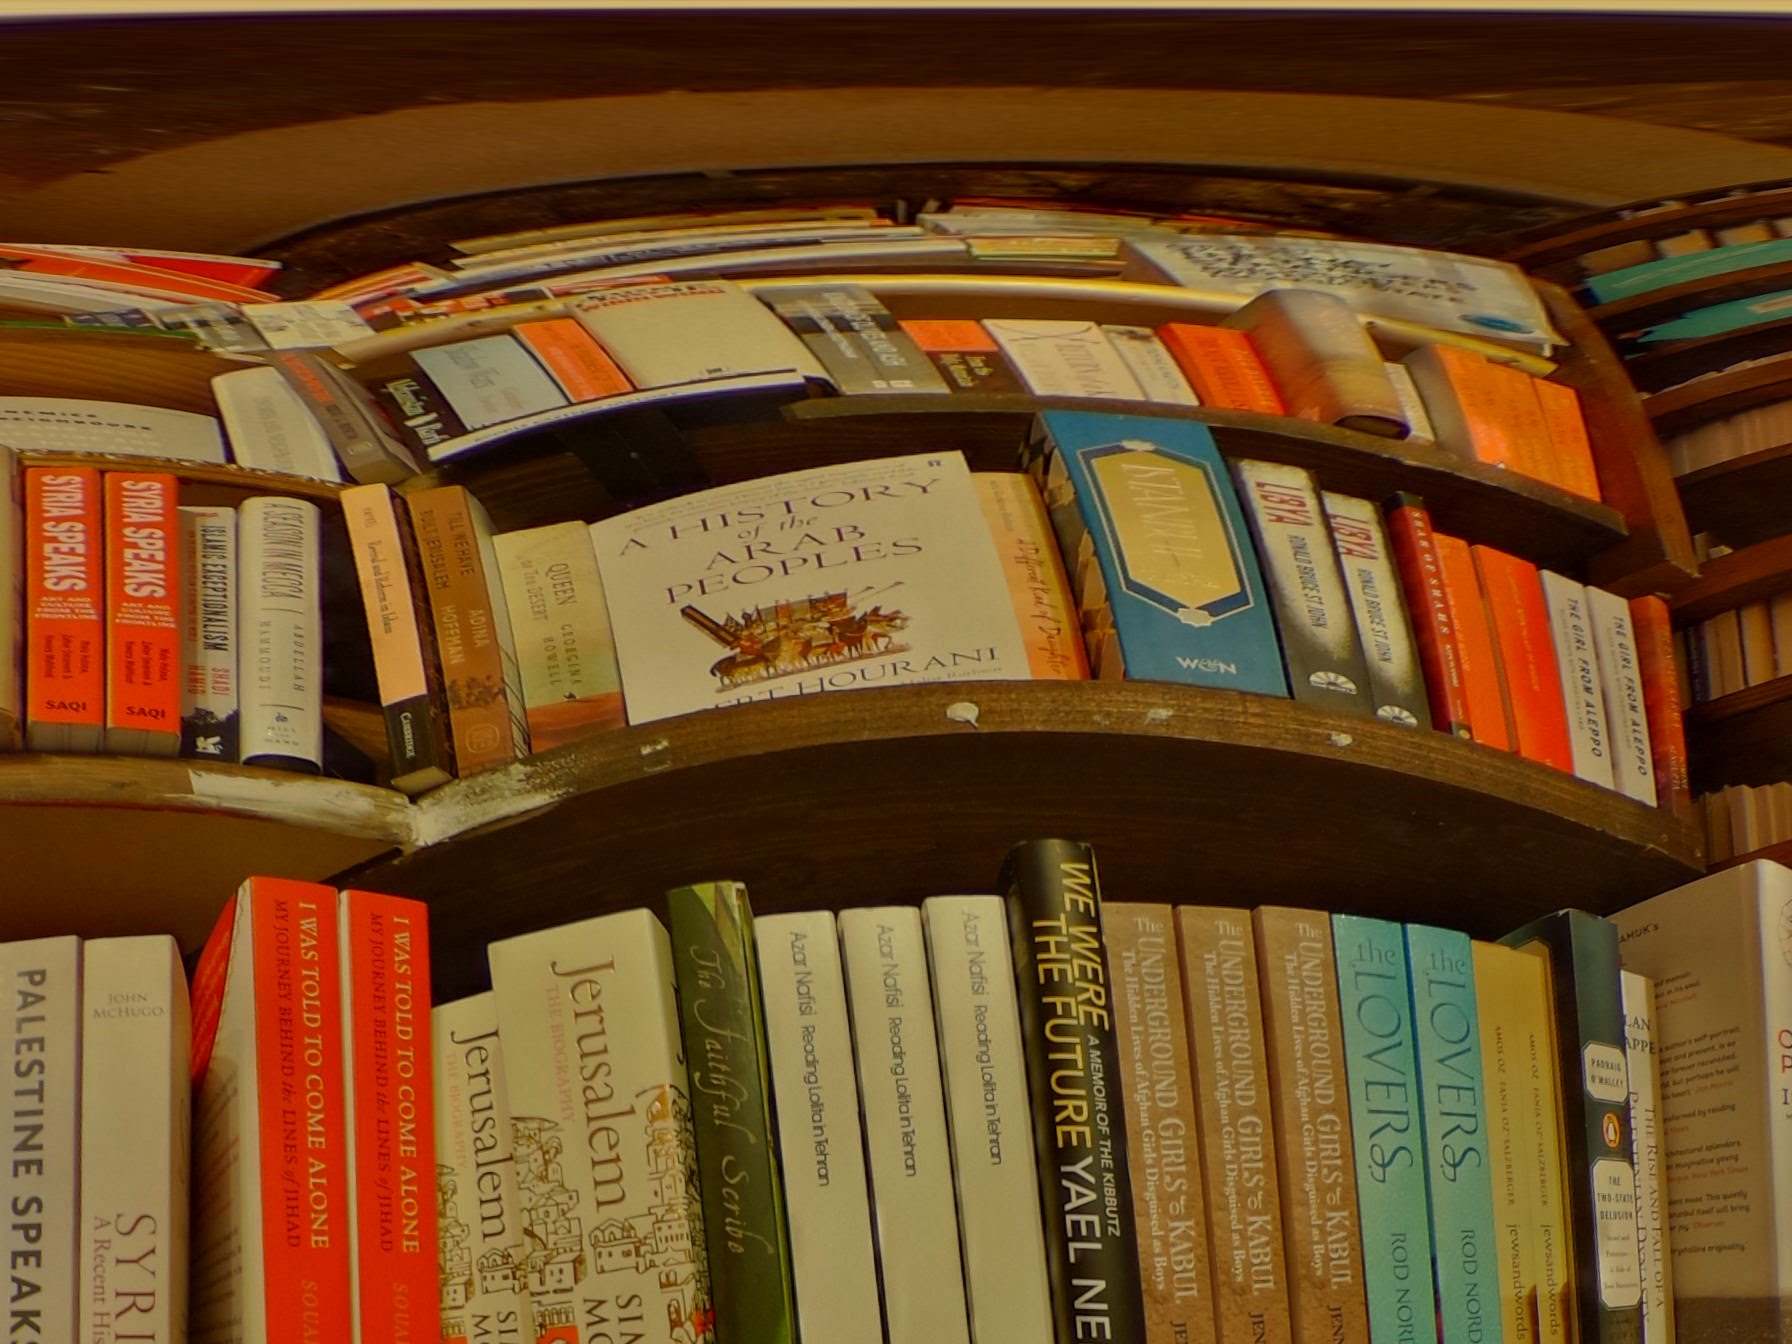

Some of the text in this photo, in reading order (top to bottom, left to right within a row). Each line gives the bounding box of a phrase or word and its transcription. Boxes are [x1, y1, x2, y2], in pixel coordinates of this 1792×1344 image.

[39, 475, 86, 593] SYRIA SPEAKS
[619, 477, 944, 558] A HISTORY
[736, 513, 820, 542] of the
[1255, 480, 1314, 527] LIBYA
[1328, 512, 1379, 560] LIBYA
[121, 479, 166, 599] SYRIA SPEAKS
[665, 537, 925, 607] PEOPLES
[704, 523, 869, 573] ARAB
[201, 525, 229, 652] ISLAMIC EXCEPTIONALISM
[545, 563, 577, 606] QUEEN
[440, 604, 466, 665] HOFFMAN
[468, 607, 489, 648] ADINA
[44, 700, 88, 713] SAQI
[1576, 658, 1594, 696] FROM
[124, 706, 166, 720] SAQI
[1581, 701, 1603, 759] ALEPPO
[1060, 862, 1110, 1032] WE WERE
[1031, 912, 1092, 1150] THE FUTURE
[9, 967, 48, 1180] PALESTINE
[300, 917, 331, 1250] WAS TOLD COME ALONE
[549, 956, 636, 1215] Jerusalem
[1352, 966, 1415, 1184] LOVERS
[451, 1025, 514, 1244] Jerusalem
[1137, 935, 1199, 1305] UNDERGROUND KABUL
[283, 1187, 302, 1249] JIHAD
[401, 1164, 421, 1254] ALONE
[720, 1154, 775, 1257] Scribe
[1057, 1155, 1104, 1264] YAEL
[1101, 1169, 1121, 1238] KIBBUTZ
[93, 1238, 112, 1305] Recent
[1390, 1230, 1411, 1282] ROD
